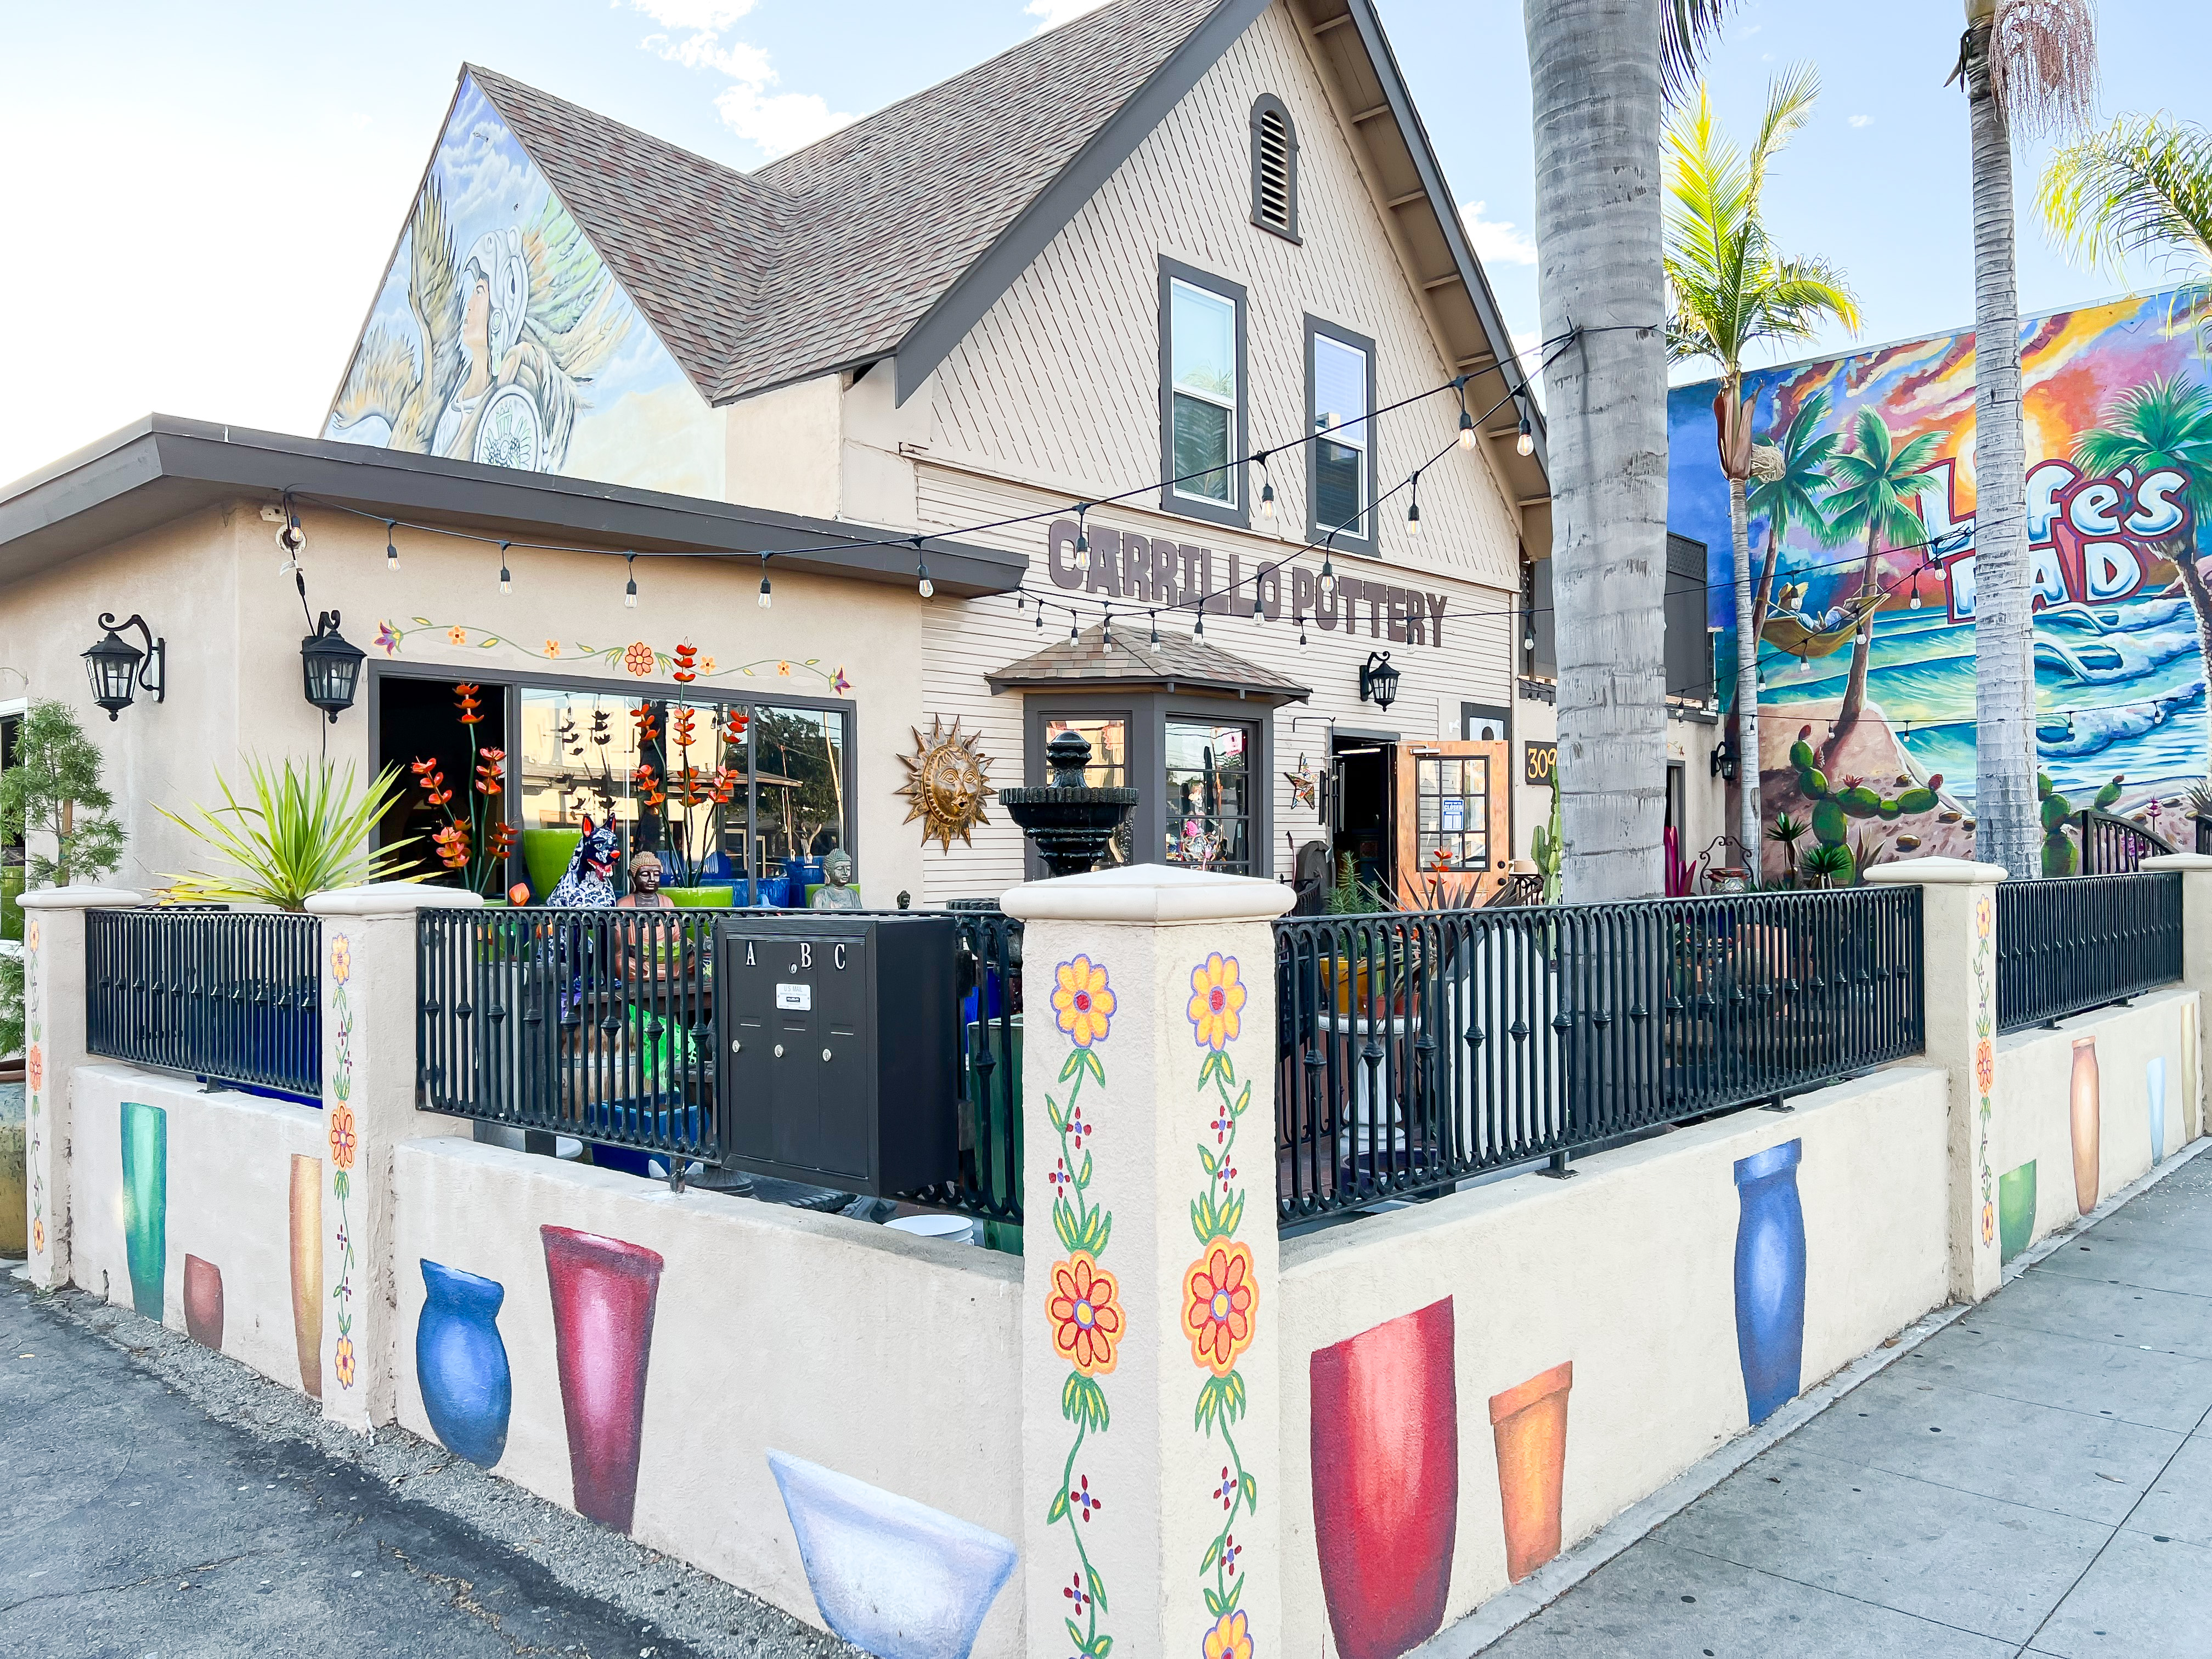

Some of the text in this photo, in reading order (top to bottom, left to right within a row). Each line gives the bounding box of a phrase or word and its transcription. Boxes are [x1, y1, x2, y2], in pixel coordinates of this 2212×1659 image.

[1917, 460, 2188, 561] Lfe's
[1049, 519, 1448, 648] CARRILLO POTTERY
[746, 941, 845, 969] A B C
